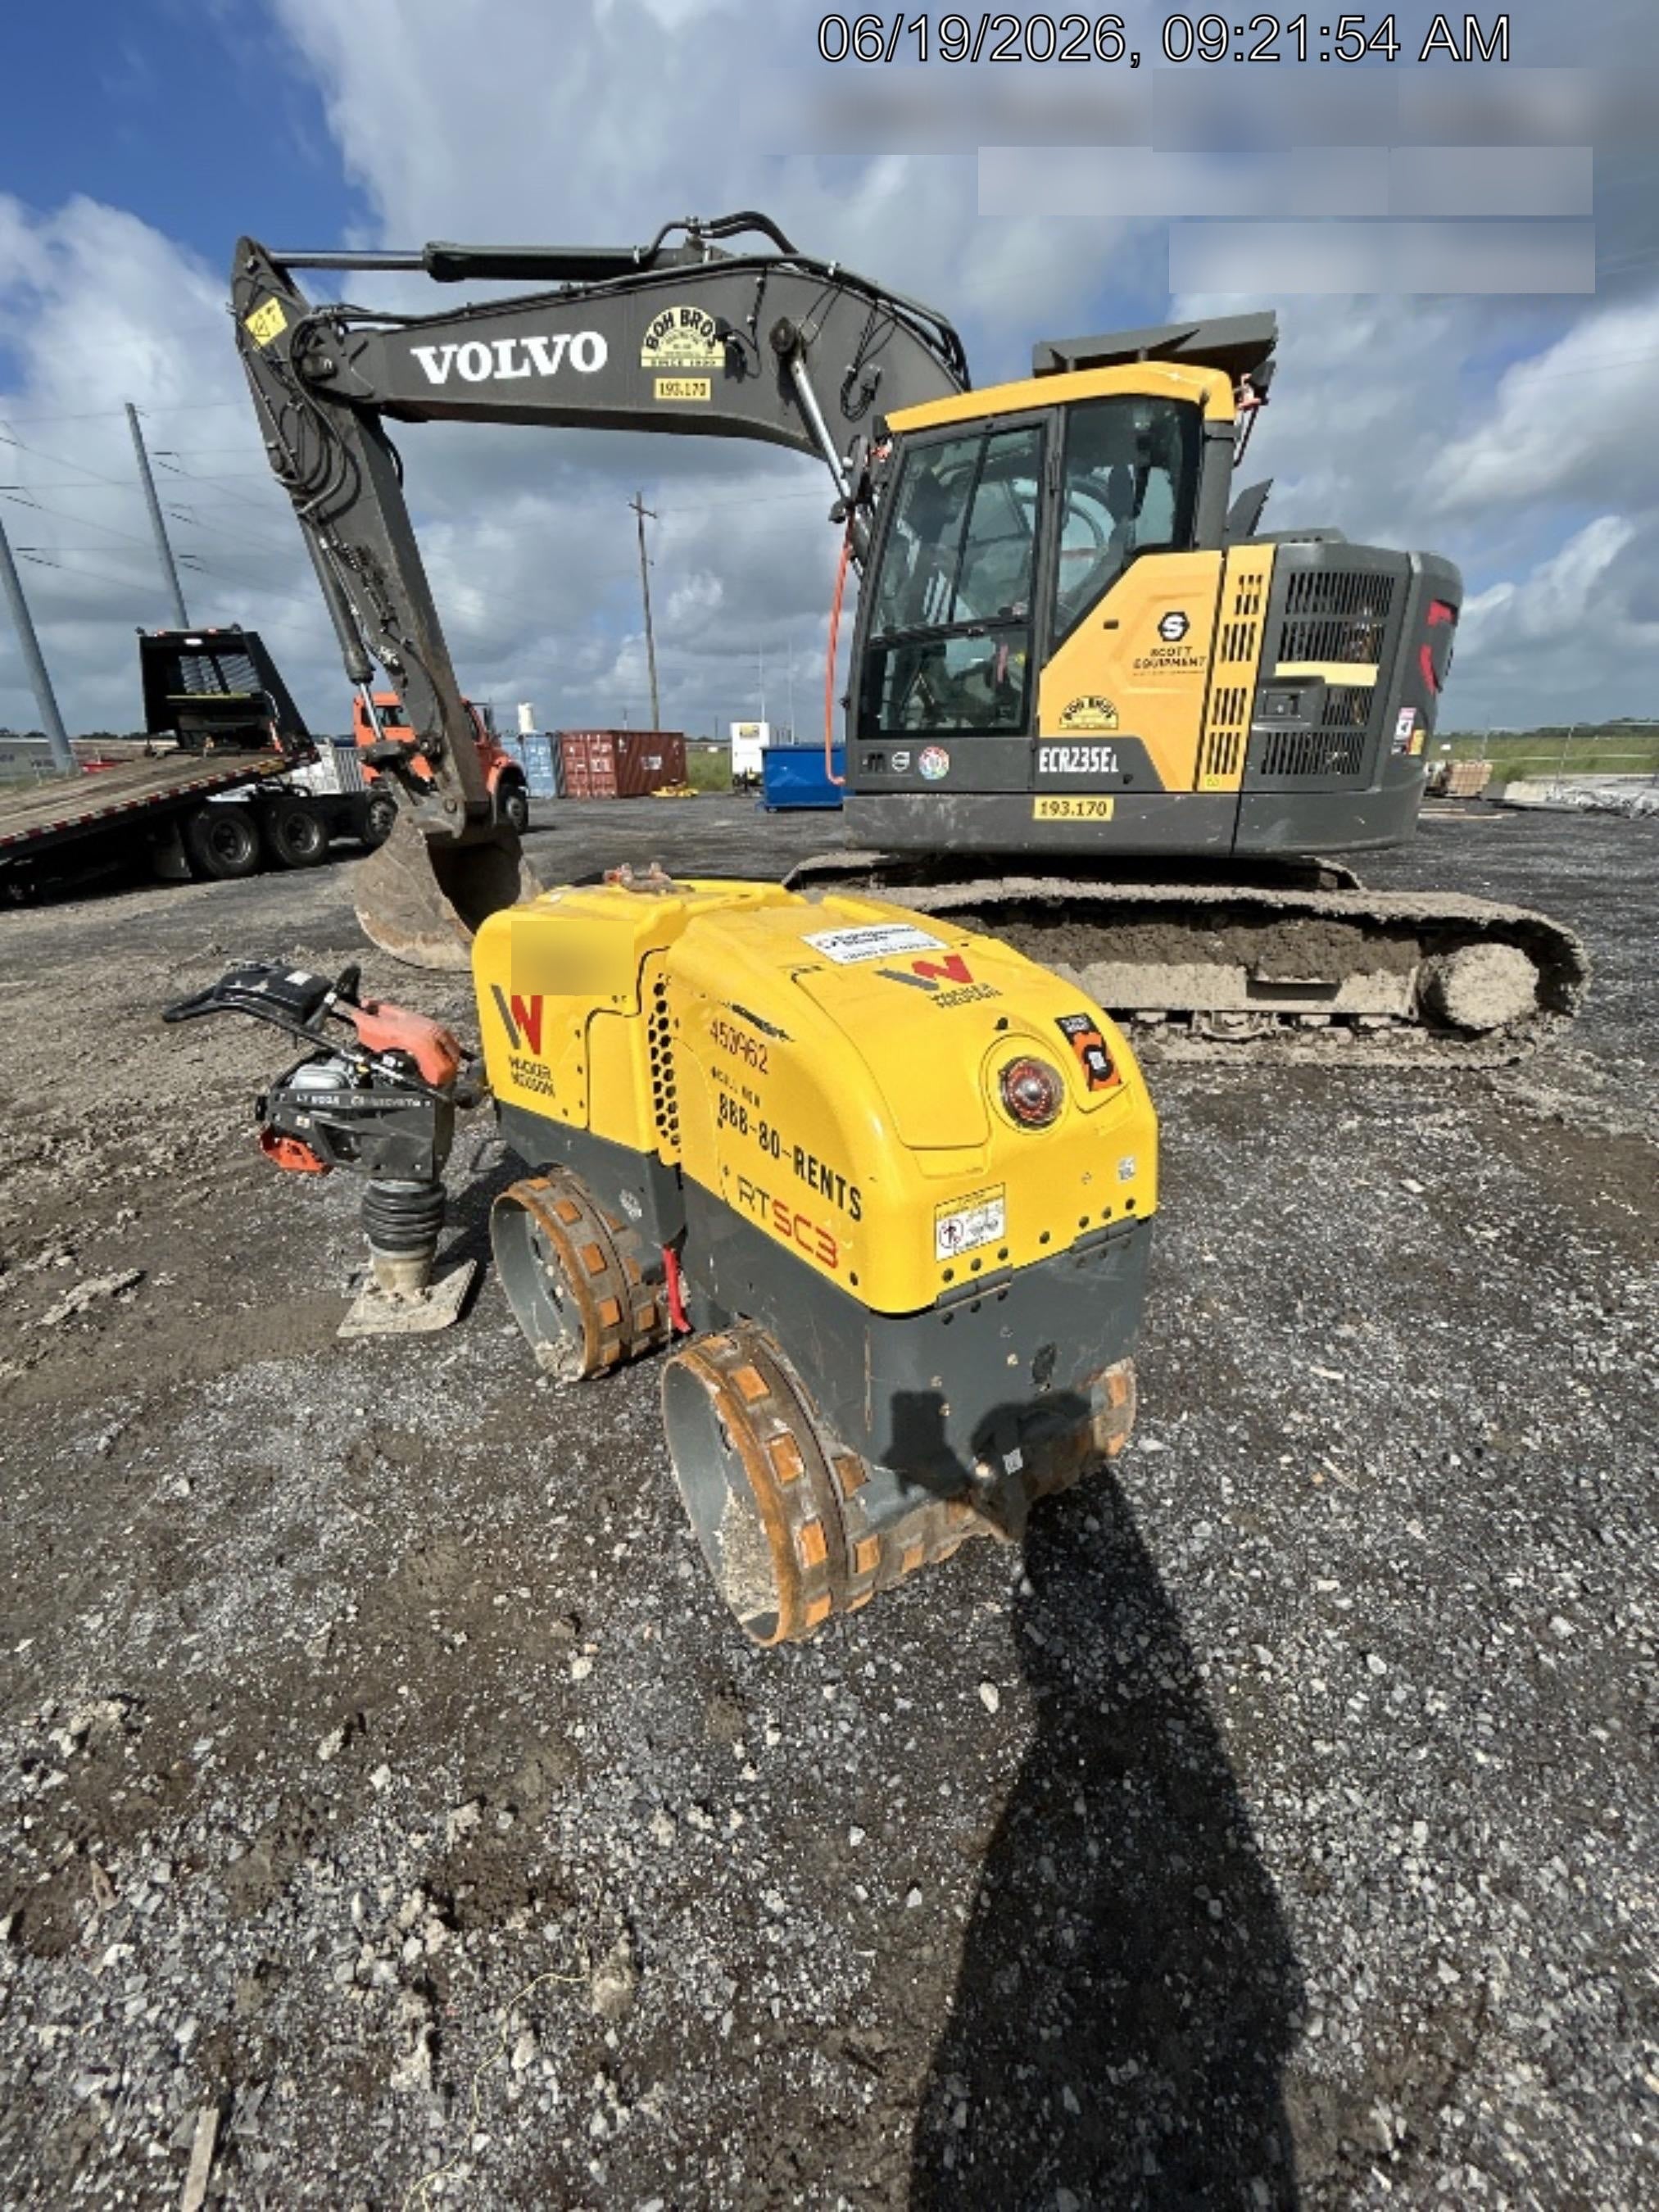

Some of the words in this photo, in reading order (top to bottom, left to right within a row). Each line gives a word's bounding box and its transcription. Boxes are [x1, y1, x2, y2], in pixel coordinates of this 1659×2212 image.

[646, 311, 674, 350] BOH
[410, 331, 608, 384] VOLVO
[1149, 646, 1193, 657] SCOTT
[1040, 800, 1107, 817] 193.170
[718, 1092, 862, 1222] 888-80-RENTS
